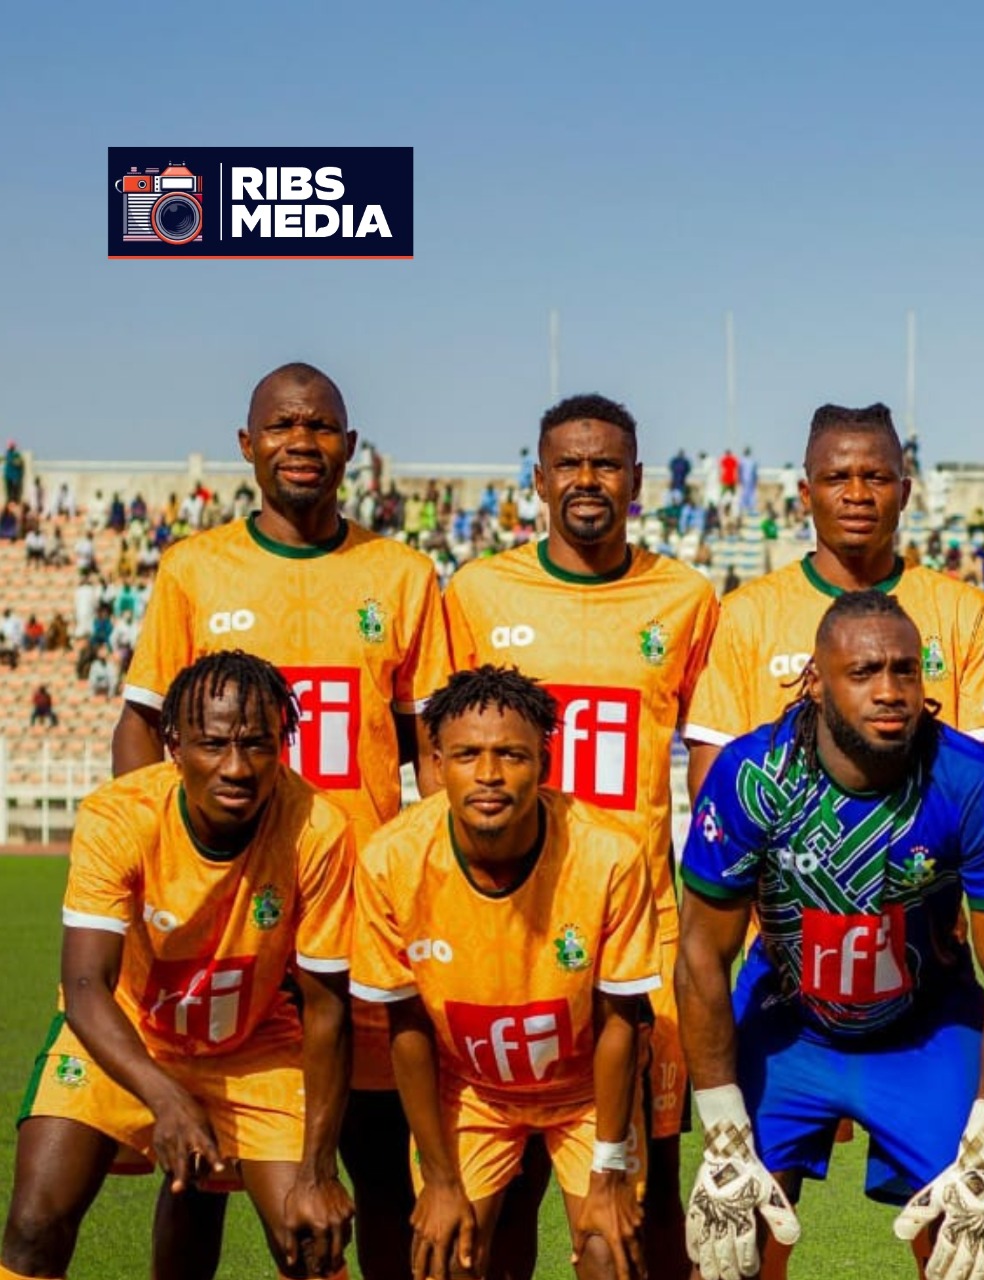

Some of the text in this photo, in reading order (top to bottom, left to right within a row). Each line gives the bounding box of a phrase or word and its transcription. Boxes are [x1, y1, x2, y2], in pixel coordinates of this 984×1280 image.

[209, 609, 254, 633] ao
[491, 625, 535, 649] ao
[548, 699, 628, 796] fi
[407, 939, 453, 963] ao
[813, 915, 903, 996] rfi
[465, 1014, 560, 1082] rfi
